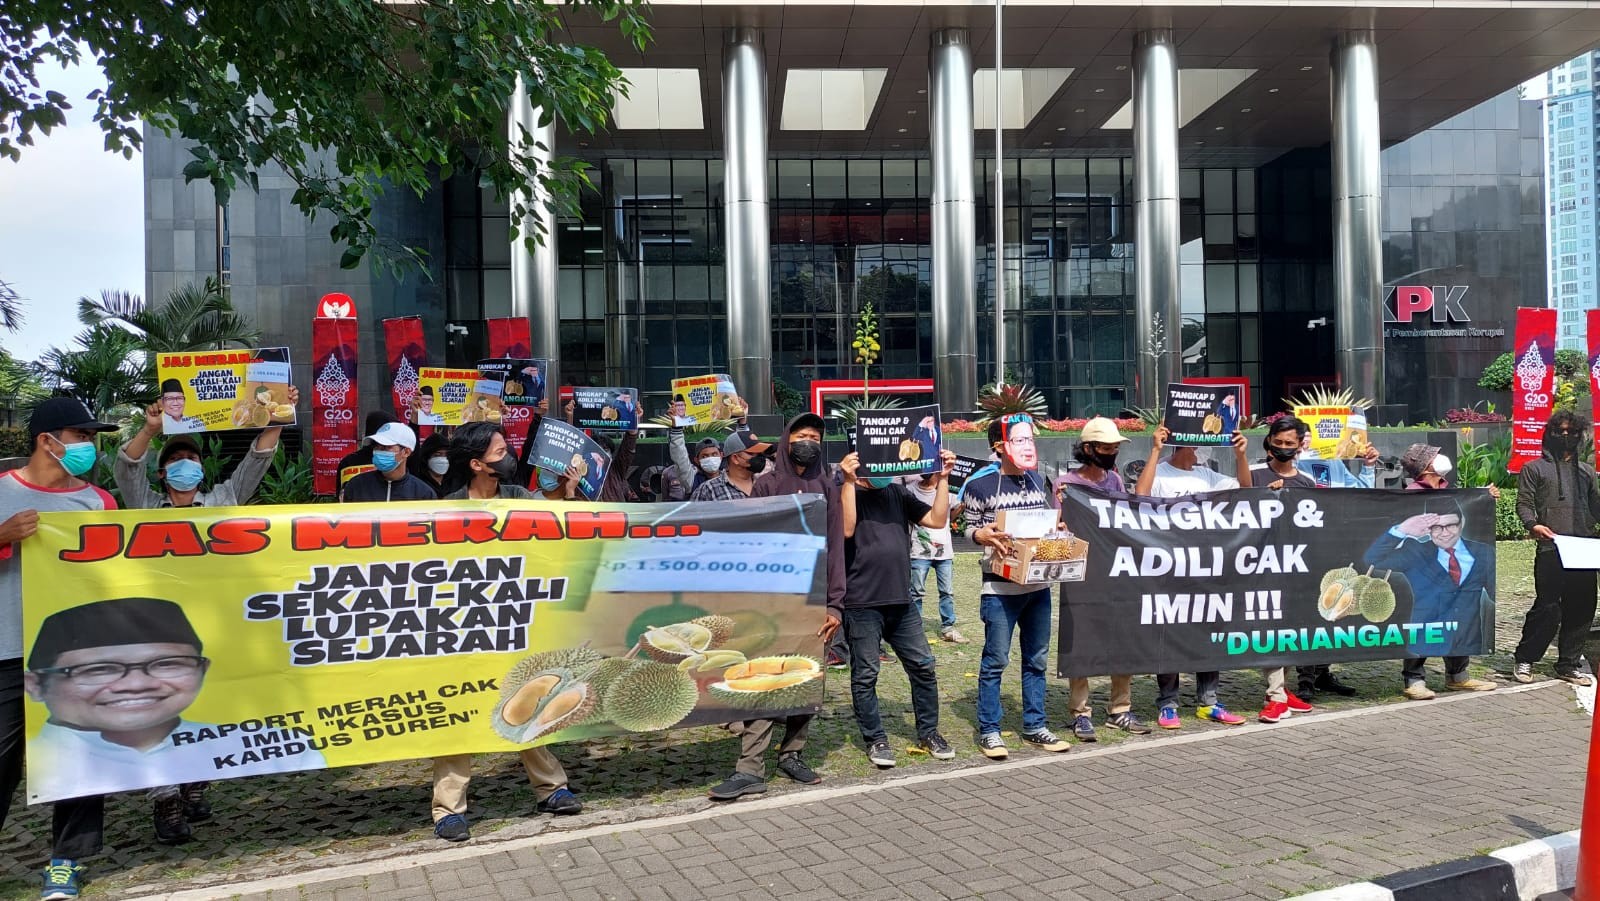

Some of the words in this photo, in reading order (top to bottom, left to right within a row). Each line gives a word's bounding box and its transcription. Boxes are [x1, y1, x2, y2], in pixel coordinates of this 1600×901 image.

[1469, 328, 1505, 338] Korupsi
[162, 355, 192, 368] JAS
[197, 369, 233, 379] JANGAN
[190, 376, 241, 387] SEKALI-KALI
[196, 384, 237, 393] LUPAKAN
[198, 391, 236, 401] SEJARAH
[1170, 391, 1209, 401] TANGKAP
[1524, 393, 1548, 404] G20
[1172, 400, 1195, 409] ADILI
[324, 409, 353, 420] G20
[1178, 409, 1197, 418] IMIN
[860, 417, 902, 426] TANGKAP
[543, 423, 579, 441] TANGKAP
[863, 427, 887, 435] ADILI
[888, 427, 906, 435] CAK
[1171, 432, 1233, 442] "DURIANGATE"
[544, 430, 566, 443] ADILI
[566, 437, 581, 450] CAK
[548, 438, 567, 450] IMIN
[870, 437, 890, 445] IMIN
[866, 459, 935, 473] "DURIANGATE"
[1090, 499, 1285, 530] TANGKAP
[1293, 499, 1325, 528] &
[59, 517, 272, 562] JAS
[291, 510, 703, 552] MERAH...
[1109, 544, 1224, 577] ADILI
[1235, 543, 1309, 574] CAK
[298, 556, 523, 592] JANGAN
[247, 578, 566, 621] SEKALI-KALI
[1140, 592, 1233, 625] IMIN
[1243, 590, 1282, 621] !!!
[286, 602, 532, 641] LUPAKAN
[1210, 621, 1459, 655] "DURIANGATE"
[293, 626, 527, 666] SEJARAH
[172, 711, 305, 747] RAPORT
[318, 690, 428, 721] MERAH
[438, 678, 500, 698] CAK
[242, 726, 315, 749] IMIN
[324, 701, 447, 732] "KASUS
[213, 731, 352, 770] KARDUS
[363, 710, 479, 739] DUREN"
